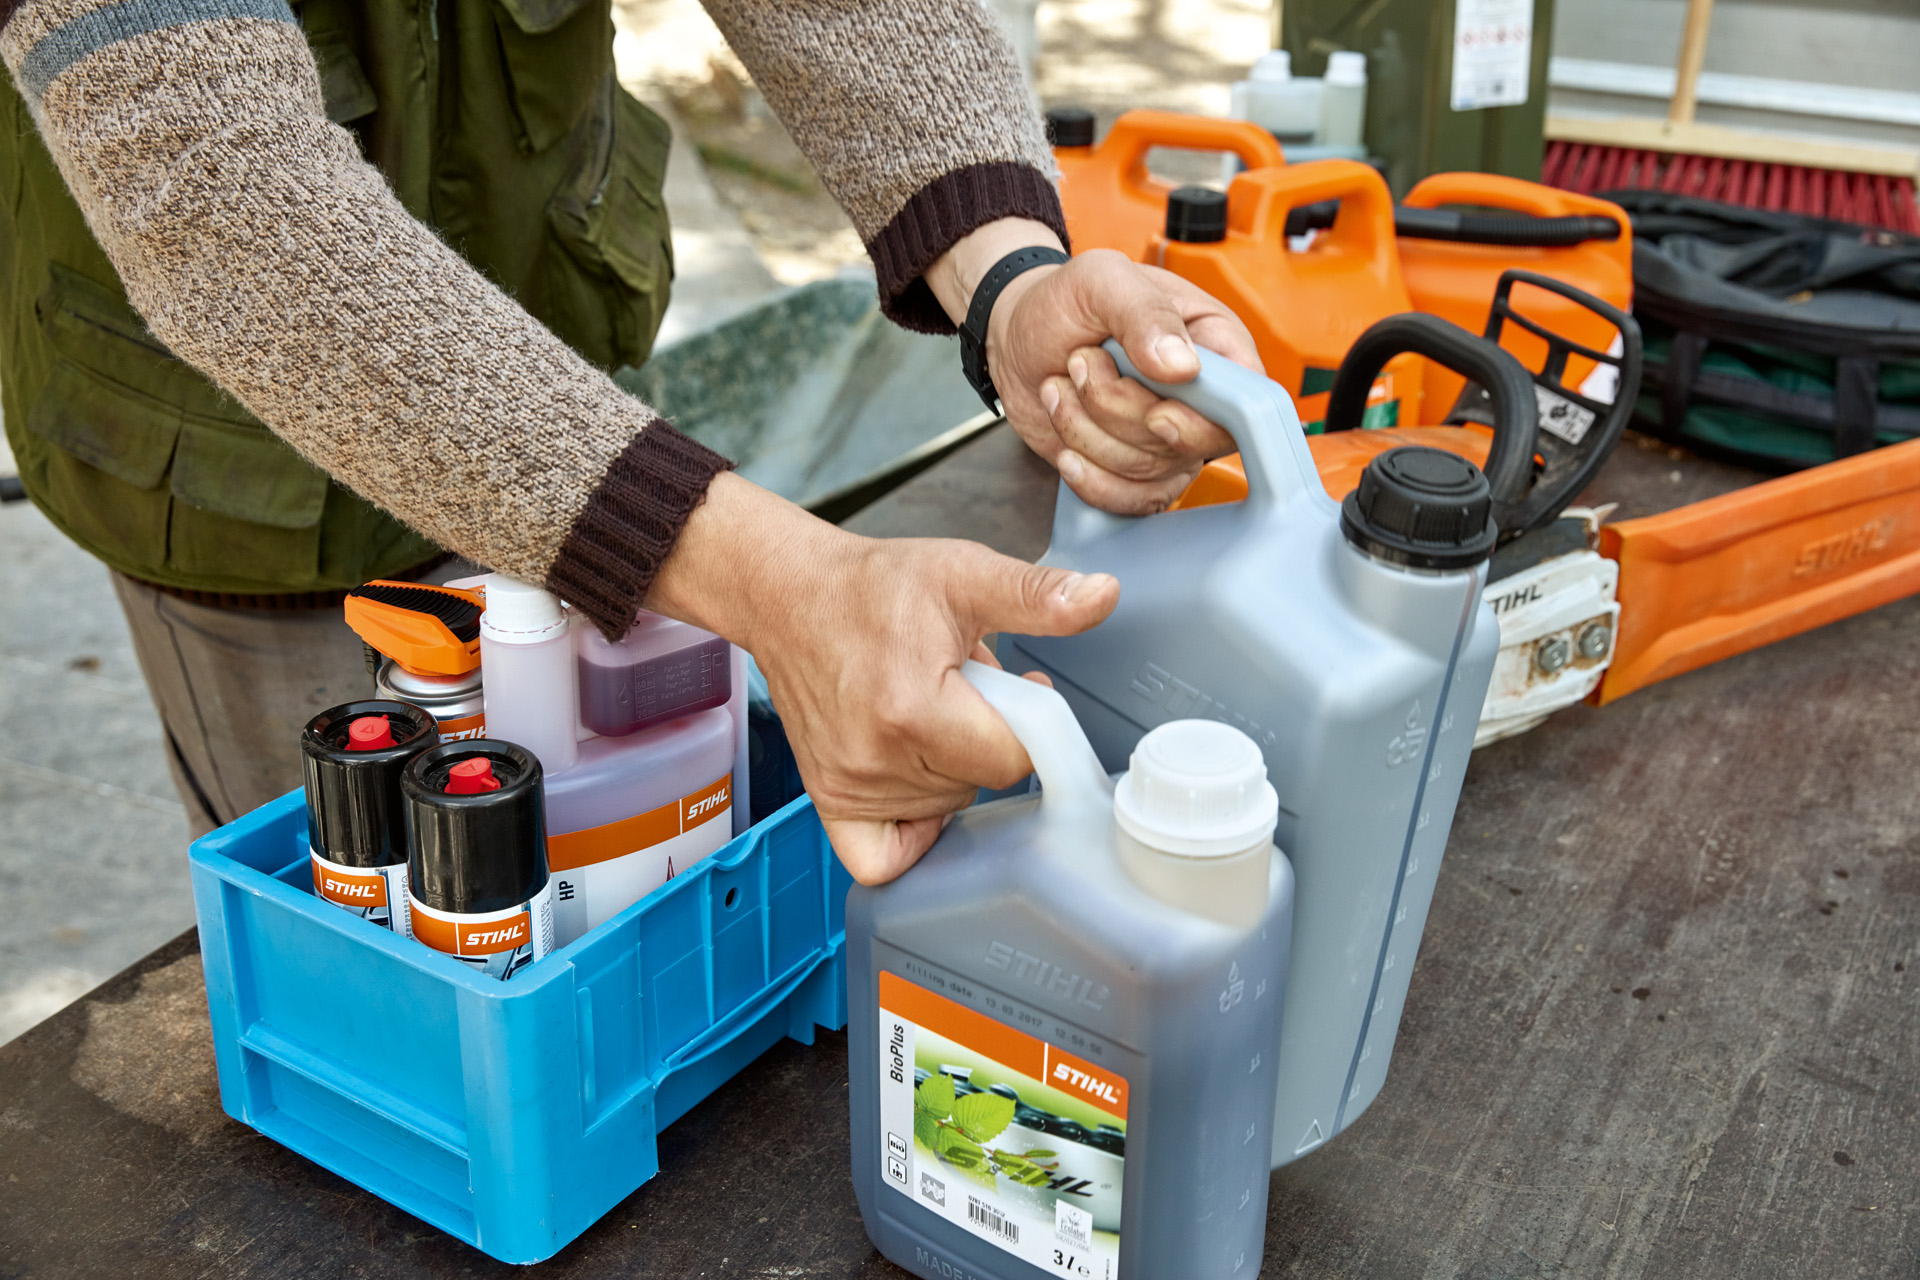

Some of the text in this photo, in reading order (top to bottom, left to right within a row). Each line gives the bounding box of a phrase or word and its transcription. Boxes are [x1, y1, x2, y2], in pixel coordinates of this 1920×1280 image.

[1793, 520, 1887, 577] STIHL
[1488, 583, 1545, 616] TIHL
[687, 788, 728, 820] STIHL
[325, 878, 376, 898] STIHL
[559, 880, 574, 901] HP
[465, 926, 523, 946] STIHL
[984, 940, 1103, 1011] STIHL
[890, 1023, 904, 1083] BioPlus
[1053, 1062, 1118, 1104] STIHL
